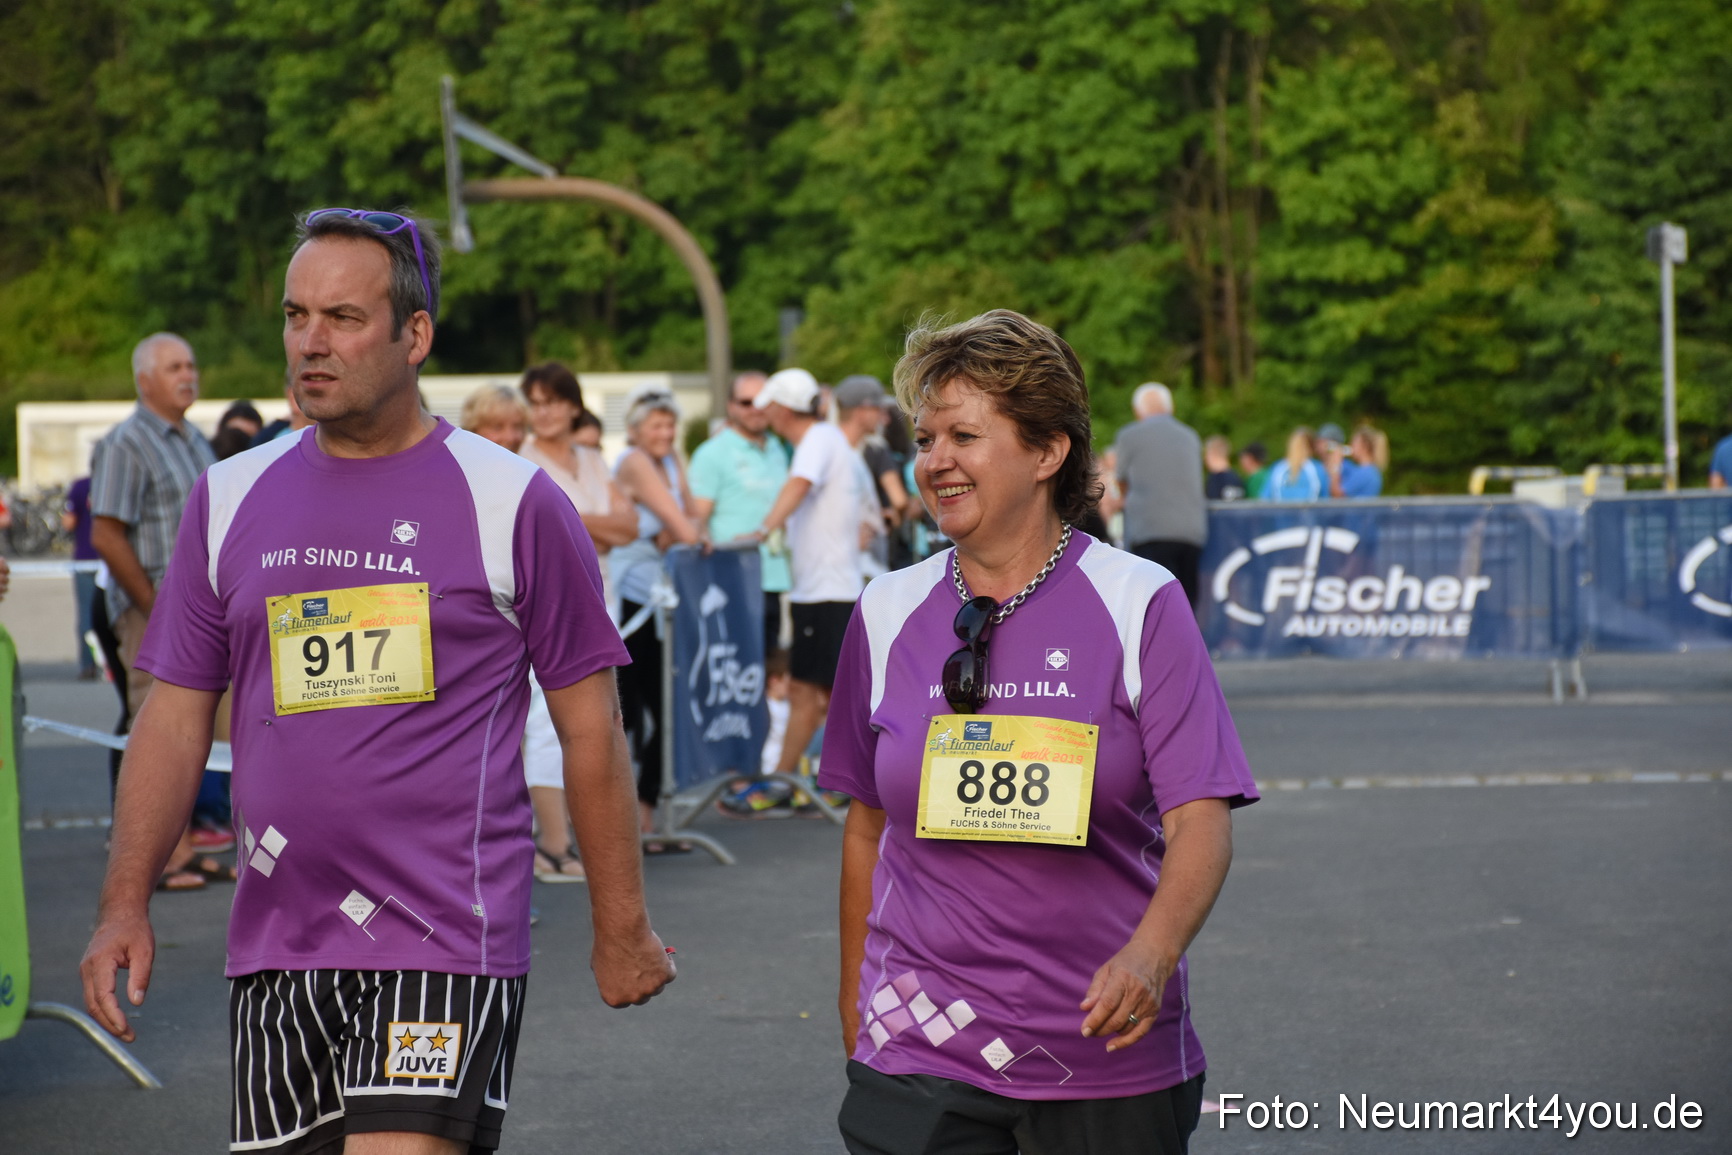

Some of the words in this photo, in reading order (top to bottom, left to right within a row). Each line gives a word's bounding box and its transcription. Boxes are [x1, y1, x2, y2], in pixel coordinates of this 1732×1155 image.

[261, 549, 297, 568] WIR
[304, 547, 358, 568] SIND
[364, 551, 421, 576] LILA.
[1262, 564, 1492, 613] Fischer
[292, 611, 353, 628] firmenlauf
[359, 613, 387, 628] walk
[389, 615, 418, 626] 2019
[1283, 614, 1472, 637] AUTOMOBILE
[303, 628, 391, 678] 917
[305, 674, 365, 690] Tuszynski
[368, 672, 396, 684] Toni
[980, 683, 1017, 698] IND
[1023, 682, 1076, 698] LILA.
[302, 690, 330, 700] FUCHS
[332, 689, 338, 697] &
[340, 687, 366, 696] Söhne
[368, 685, 400, 694] Service
[950, 738, 1015, 752] firmenlauf
[1021, 747, 1050, 762] walk
[1052, 752, 1084, 764] 2019
[957, 759, 1050, 807] 888
[964, 806, 1006, 819] Friedel
[1010, 808, 1040, 820] Thea
[950, 819, 980, 828] FUCHS
[983, 820, 989, 828] &
[991, 820, 1017, 830] Söhne
[1019, 822, 1051, 831] Service
[395, 1056, 447, 1073] JUVE
